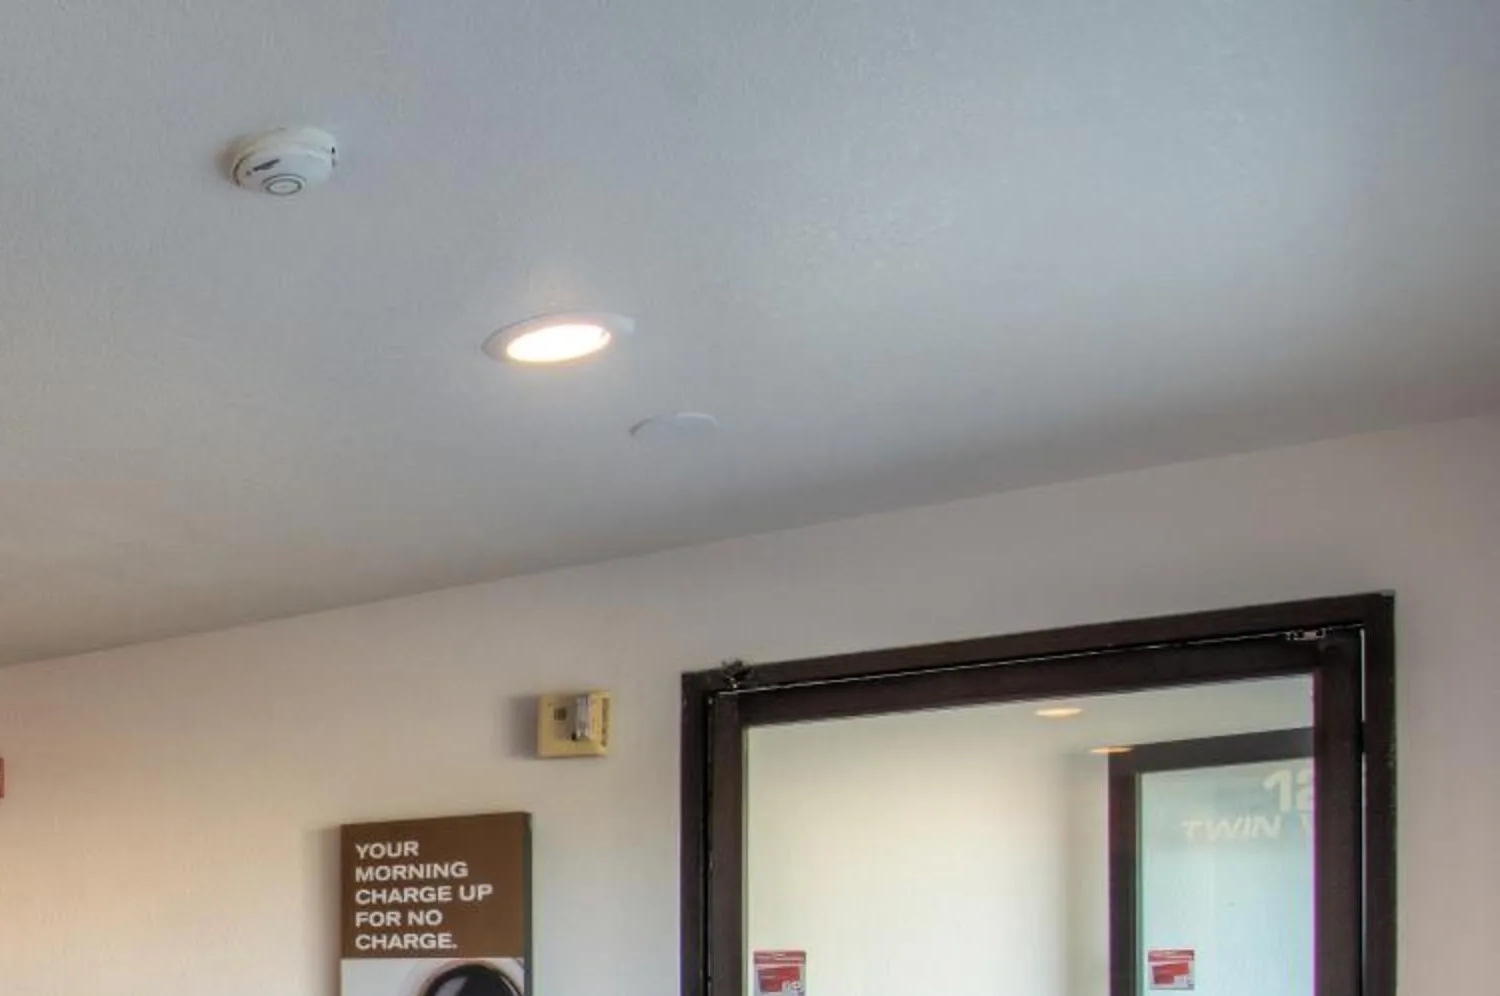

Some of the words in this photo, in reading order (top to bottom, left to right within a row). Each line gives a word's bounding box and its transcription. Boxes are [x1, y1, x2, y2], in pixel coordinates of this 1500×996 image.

[1182, 815, 1281, 840] TWIN
[356, 840, 419, 859] YOUR
[355, 861, 469, 883] MORNING
[355, 885, 453, 905] CHARGE
[459, 883, 494, 901] UP
[355, 911, 401, 928] FOR
[408, 909, 443, 926] NO
[355, 933, 458, 951] CHARGE.
